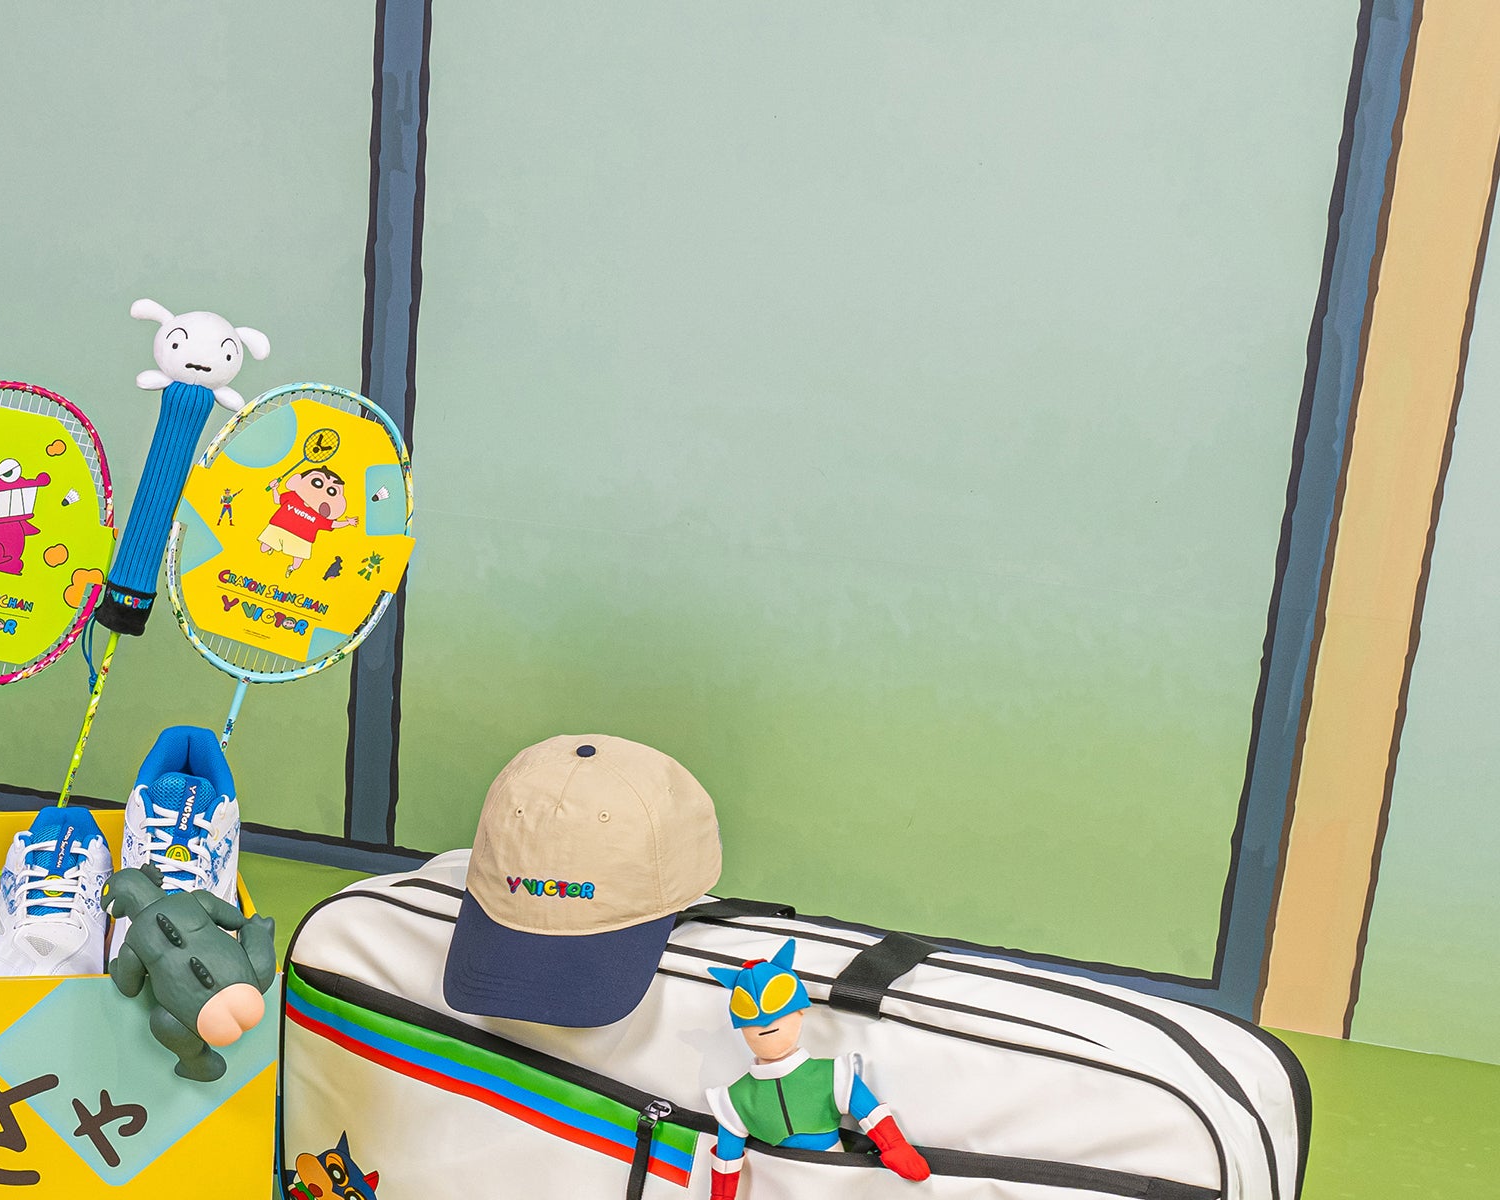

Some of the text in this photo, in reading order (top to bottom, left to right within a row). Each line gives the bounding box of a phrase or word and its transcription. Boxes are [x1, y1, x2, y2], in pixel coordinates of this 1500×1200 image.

[294, 506, 317, 523] VICTOR
[218, 569, 329, 615] CRAYON SHINCHAN
[241, 601, 309, 636] VICTOR
[179, 795, 195, 831] VICTOR
[522, 878, 596, 900] VICTOR
